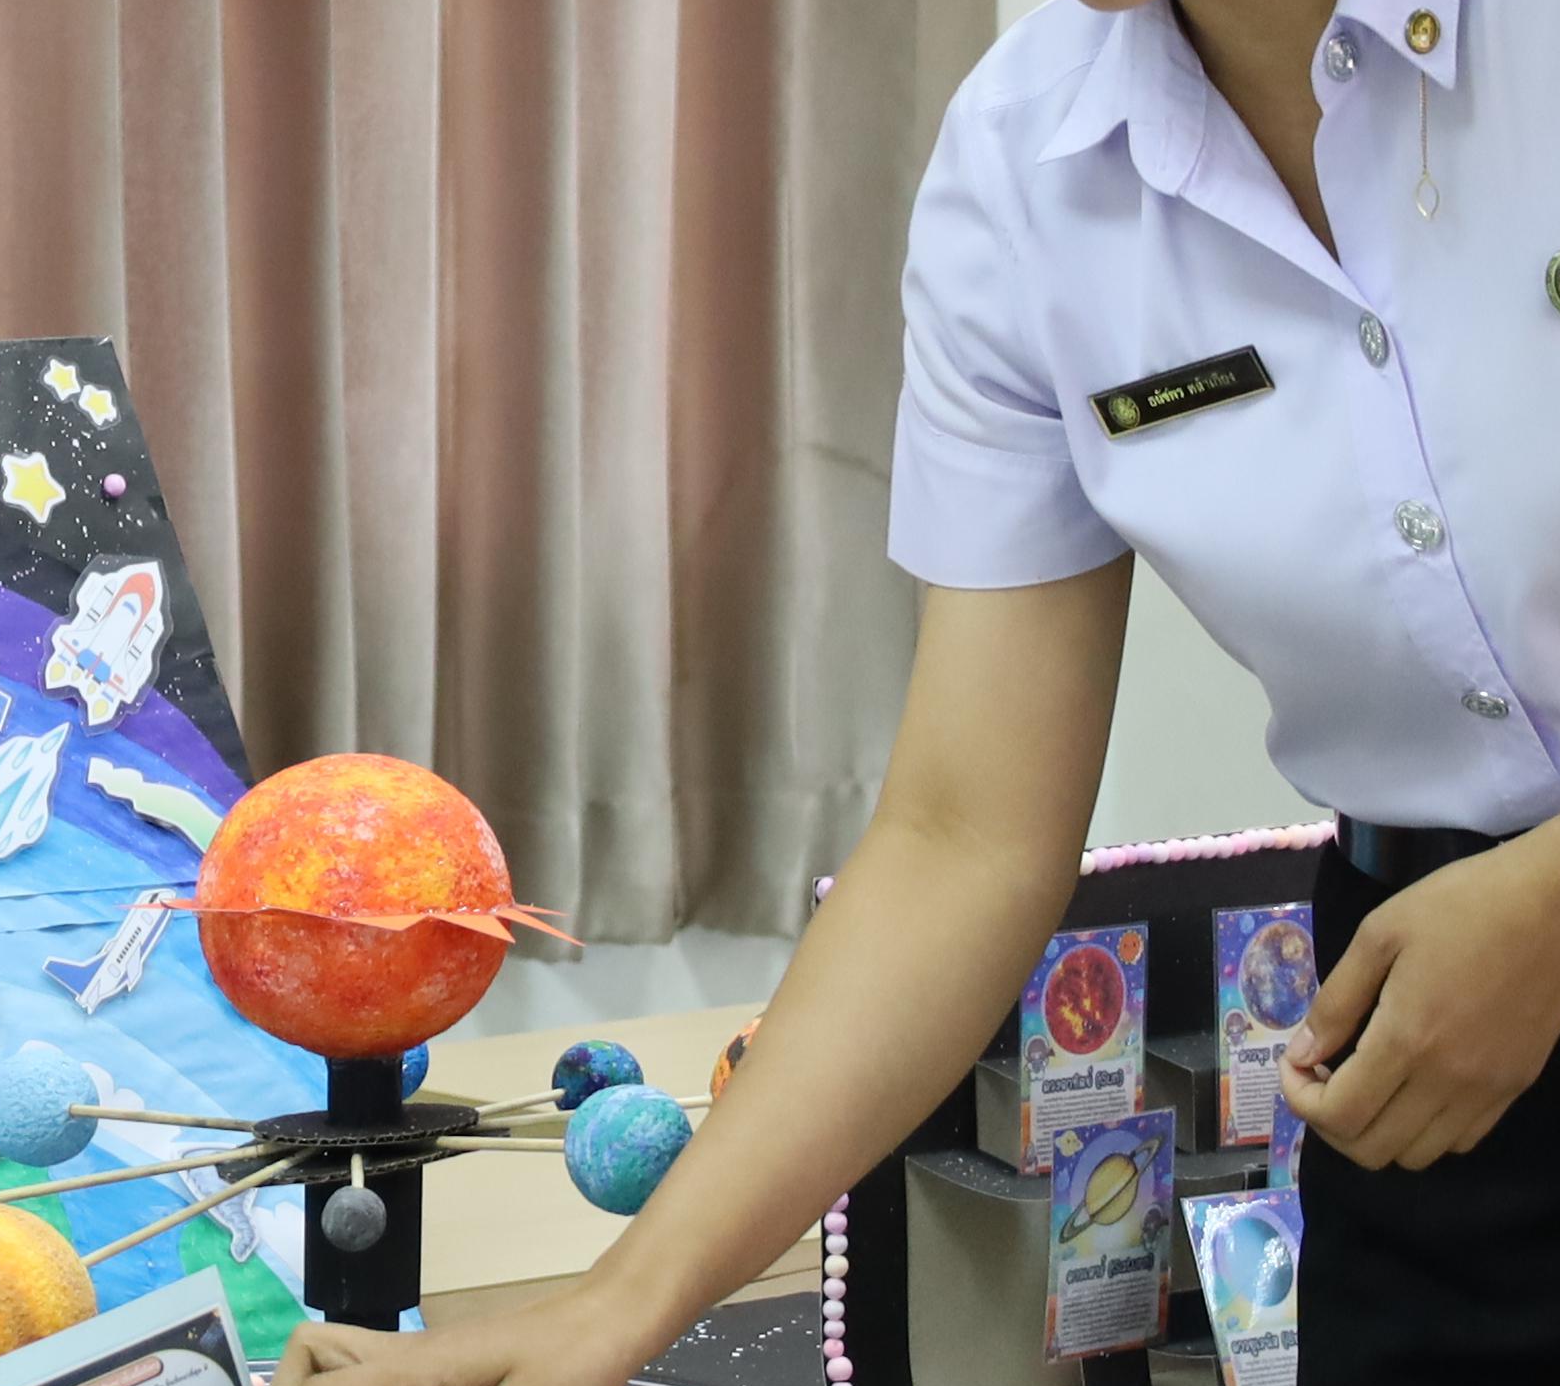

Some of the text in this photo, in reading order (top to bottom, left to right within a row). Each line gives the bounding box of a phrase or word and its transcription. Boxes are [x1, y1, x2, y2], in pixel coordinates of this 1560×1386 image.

[1238, 1047, 1270, 1066] ดาวพุธ
[1042, 1065, 1125, 1094] ดวงอาทิตย์ (Sun)
[1066, 1252, 1155, 1285] ดาวเสาร์ (Saturn)
